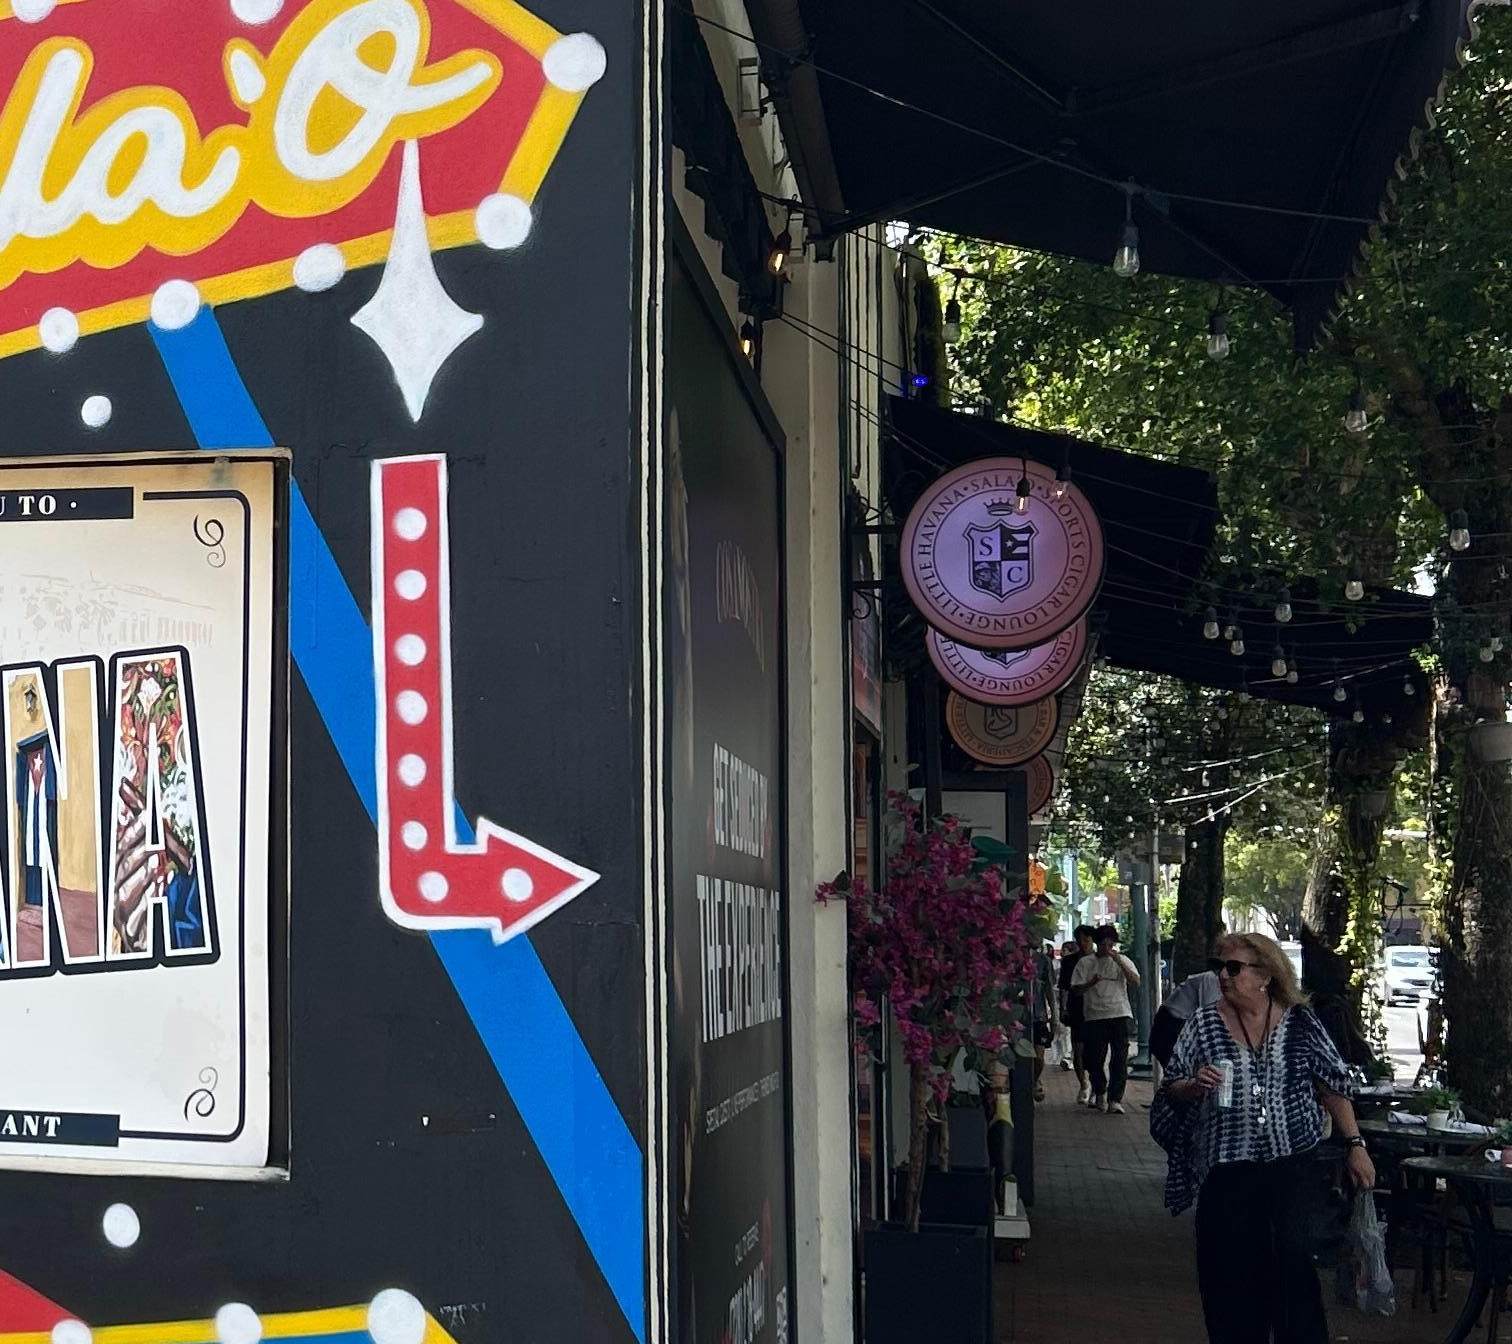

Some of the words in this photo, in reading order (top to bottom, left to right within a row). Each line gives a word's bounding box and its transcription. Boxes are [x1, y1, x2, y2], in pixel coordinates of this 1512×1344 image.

[18, 493, 58, 516] TO
[918, 487, 963, 555] HAVANA
[919, 559, 960, 616] LITTLE
[1046, 554, 1085, 609] CIGAR
[964, 605, 1049, 632] LOUNGE
[976, 674, 1044, 692] LOUNGE
[713, 742, 729, 847] GET
[696, 874, 724, 1043] THE
[724, 879, 781, 1036] EXPERIENCE
